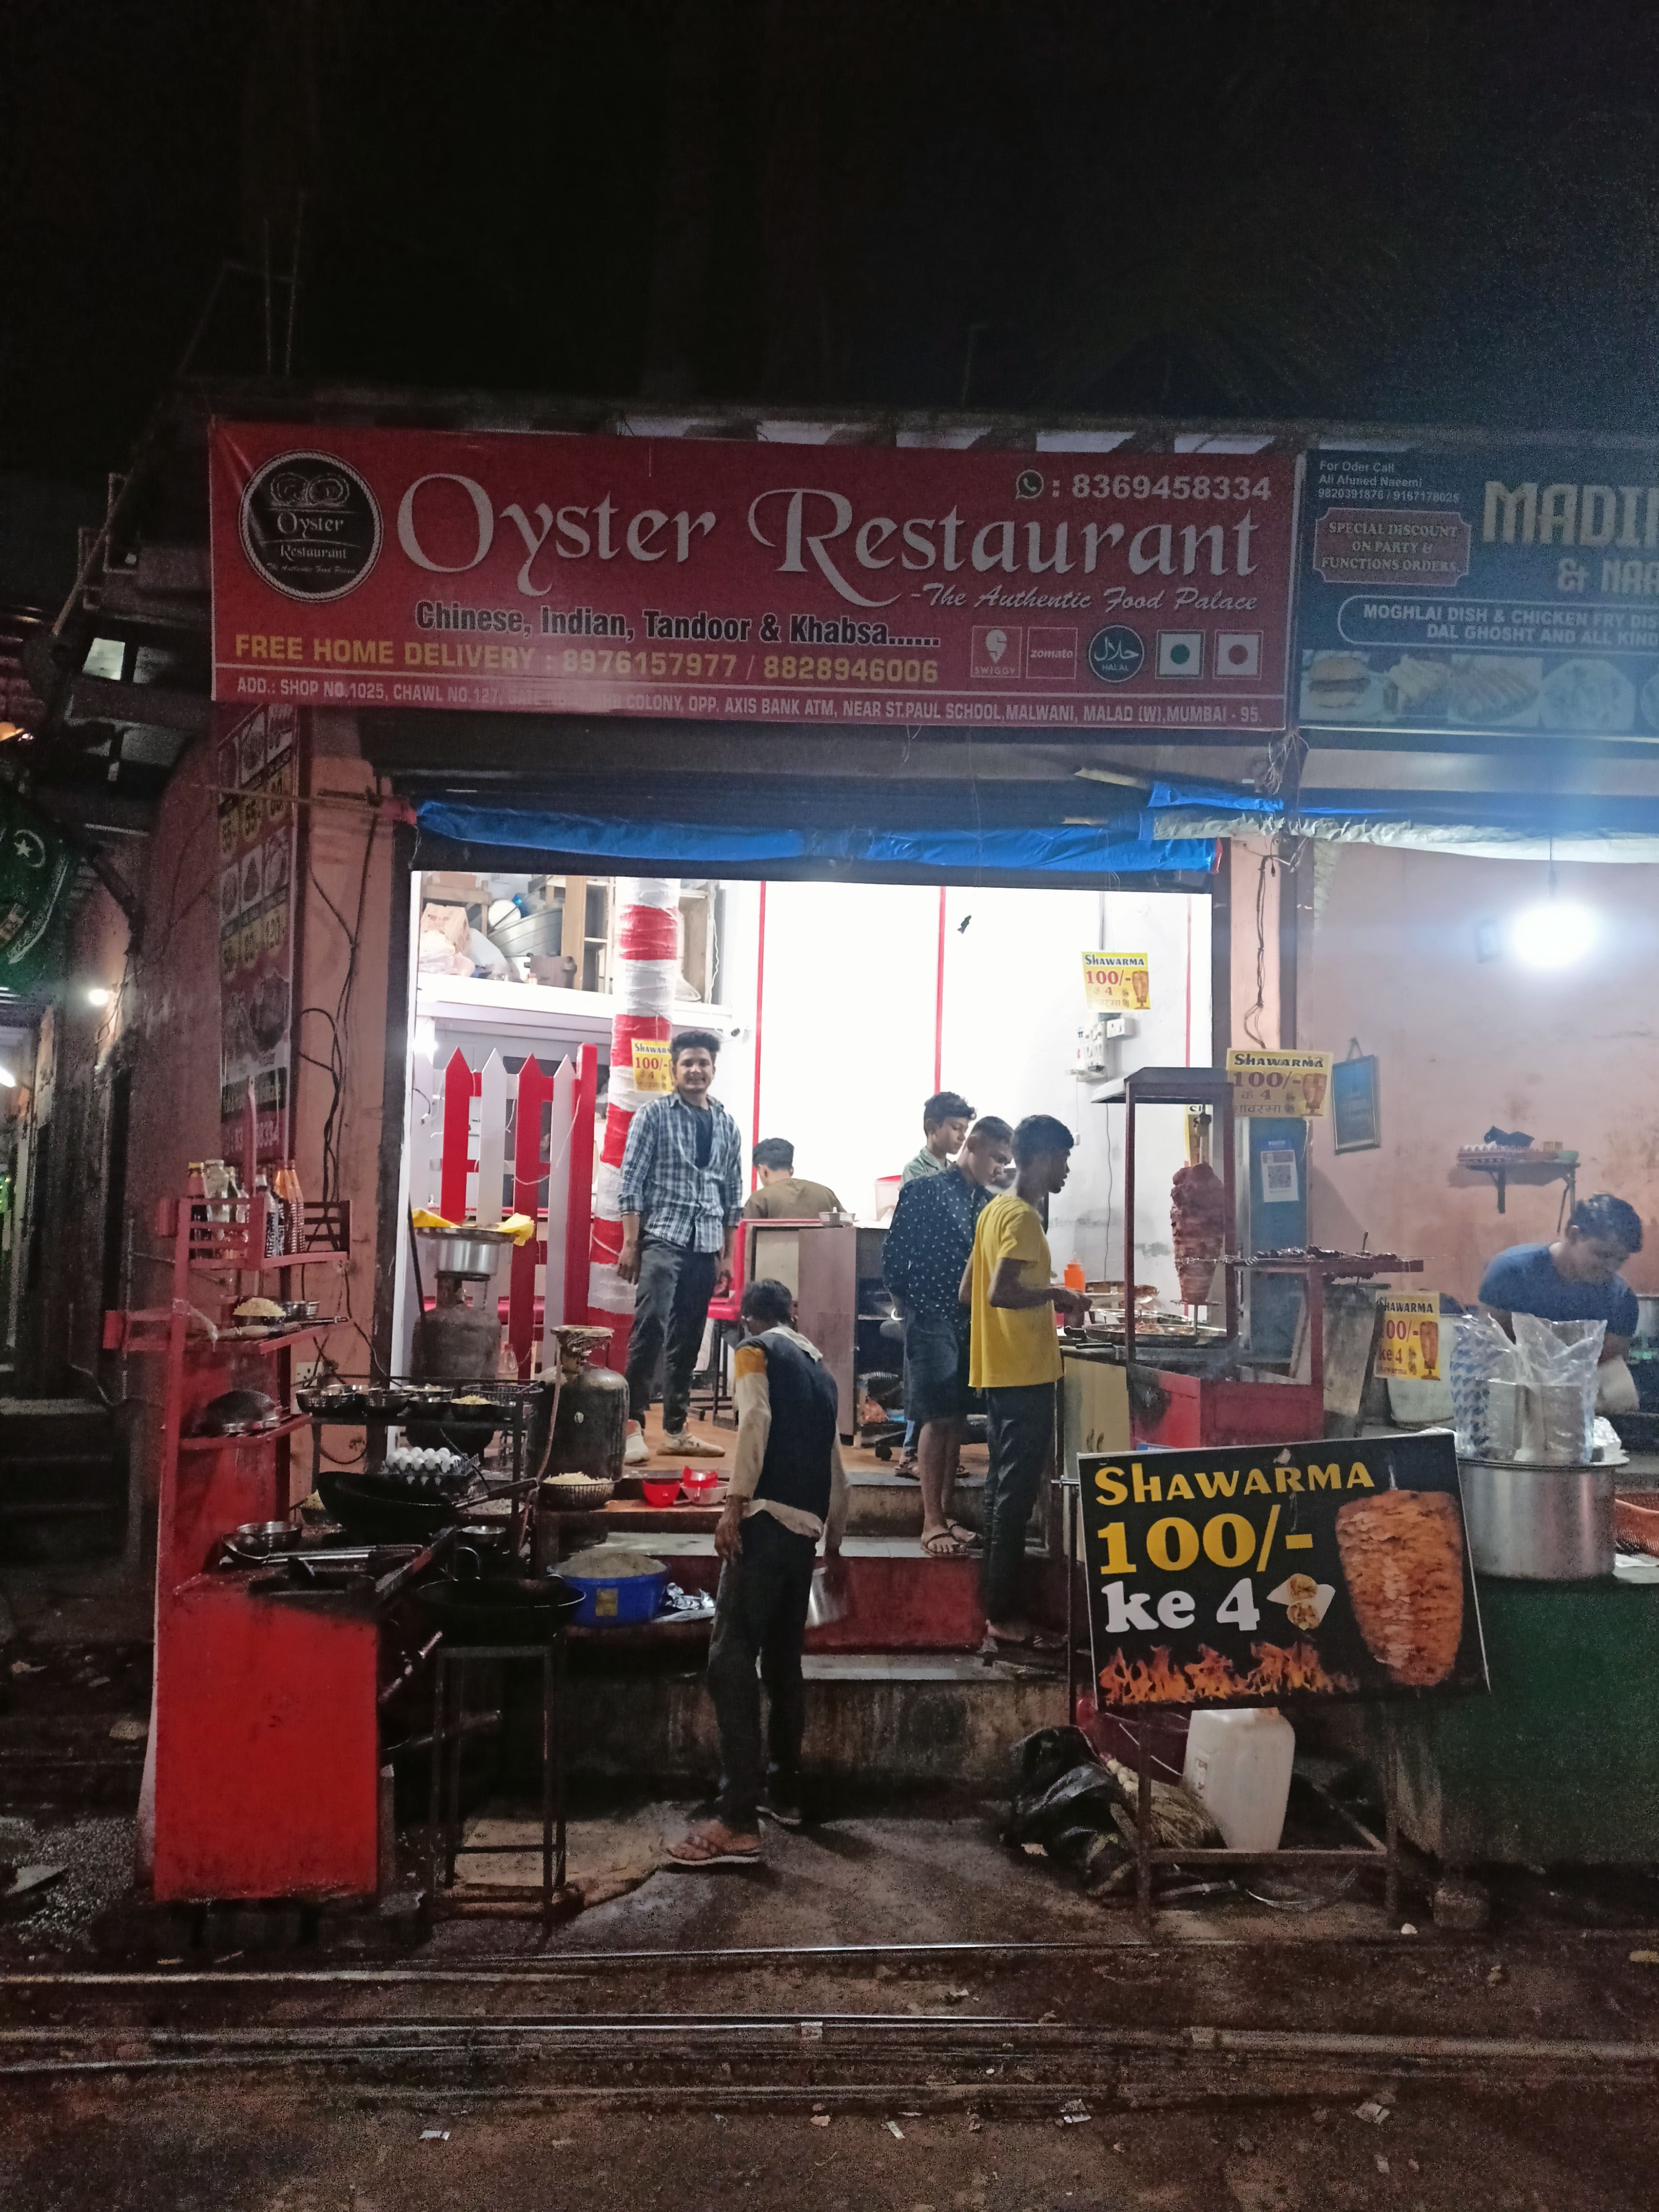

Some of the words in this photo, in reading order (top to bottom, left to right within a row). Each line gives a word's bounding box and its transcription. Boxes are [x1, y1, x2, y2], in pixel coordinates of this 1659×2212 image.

[1320, 461, 1338, 471] For
[1072, 475, 1272, 503] 8369458334
[277, 511, 343, 540] Oyster
[1329, 521, 1385, 535] SPECIAL
[1388, 523, 1458, 537] DISCOUNT
[397, 473, 716, 597] Oyster
[748, 488, 1260, 609] Restaurant
[1352, 541, 1371, 552] ON
[1375, 542, 1418, 553] PARTY
[1321, 557, 1400, 571] FUNCTIONS
[1558, 558, 1591, 594] &
[974, 584, 1091, 608] Authentic
[1103, 586, 1162, 611] Food
[1172, 588, 1258, 611] Palace
[415, 600, 531, 638] Chinese,
[541, 605, 634, 643] Indian,
[642, 608, 750, 642] Tandoor
[760, 614, 786, 642] &
[1363, 604, 1441, 621] MOGHLAI
[1448, 606, 1487, 623] DISH
[1493, 609, 1505, 623] &
[1512, 609, 1587, 626] CHICKEN
[1593, 612, 1625, 628] FRY
[1427, 623, 1459, 640] DAL
[1465, 624, 1536, 642] GHOSHT
[1540, 628, 1577, 644] AND
[1580, 630, 1611, 645] ALL
[235, 634, 303, 660] FREE
[313, 638, 394, 665] HOME
[404, 640, 535, 670] DELIVERY
[563, 648, 738, 678] 8976157977
[763, 655, 939, 683] 8828946006
[1029, 649, 1073, 659] zomato
[280, 678, 318, 697] SHOP
[393, 684, 442, 703] CHAWL
[628, 695, 683, 713] COLONY,
[688, 697, 719, 713] OPP.
[725, 697, 757, 714] AXIS
[761, 698, 800, 715] BANK
[805, 700, 838, 717] ATM,
[843, 701, 881, 717] NEAR
[1084, 706, 1133, 721] MALAD
[1086, 970, 1131, 986] 100/-
[1105, 986, 1113, 995] 4
[635, 1057, 668, 1071] 100/-
[1233, 1071, 1301, 1090] 100/-
[1260, 1089, 1272, 1100] 4
[1381, 1319, 1419, 1343] 00/-
[1395, 1348, 1402, 1364] 4
[1097, 1504, 1314, 1575] 100/-
[1101, 1581, 1195, 1633] ke
[1216, 1578, 1260, 1631] 4
